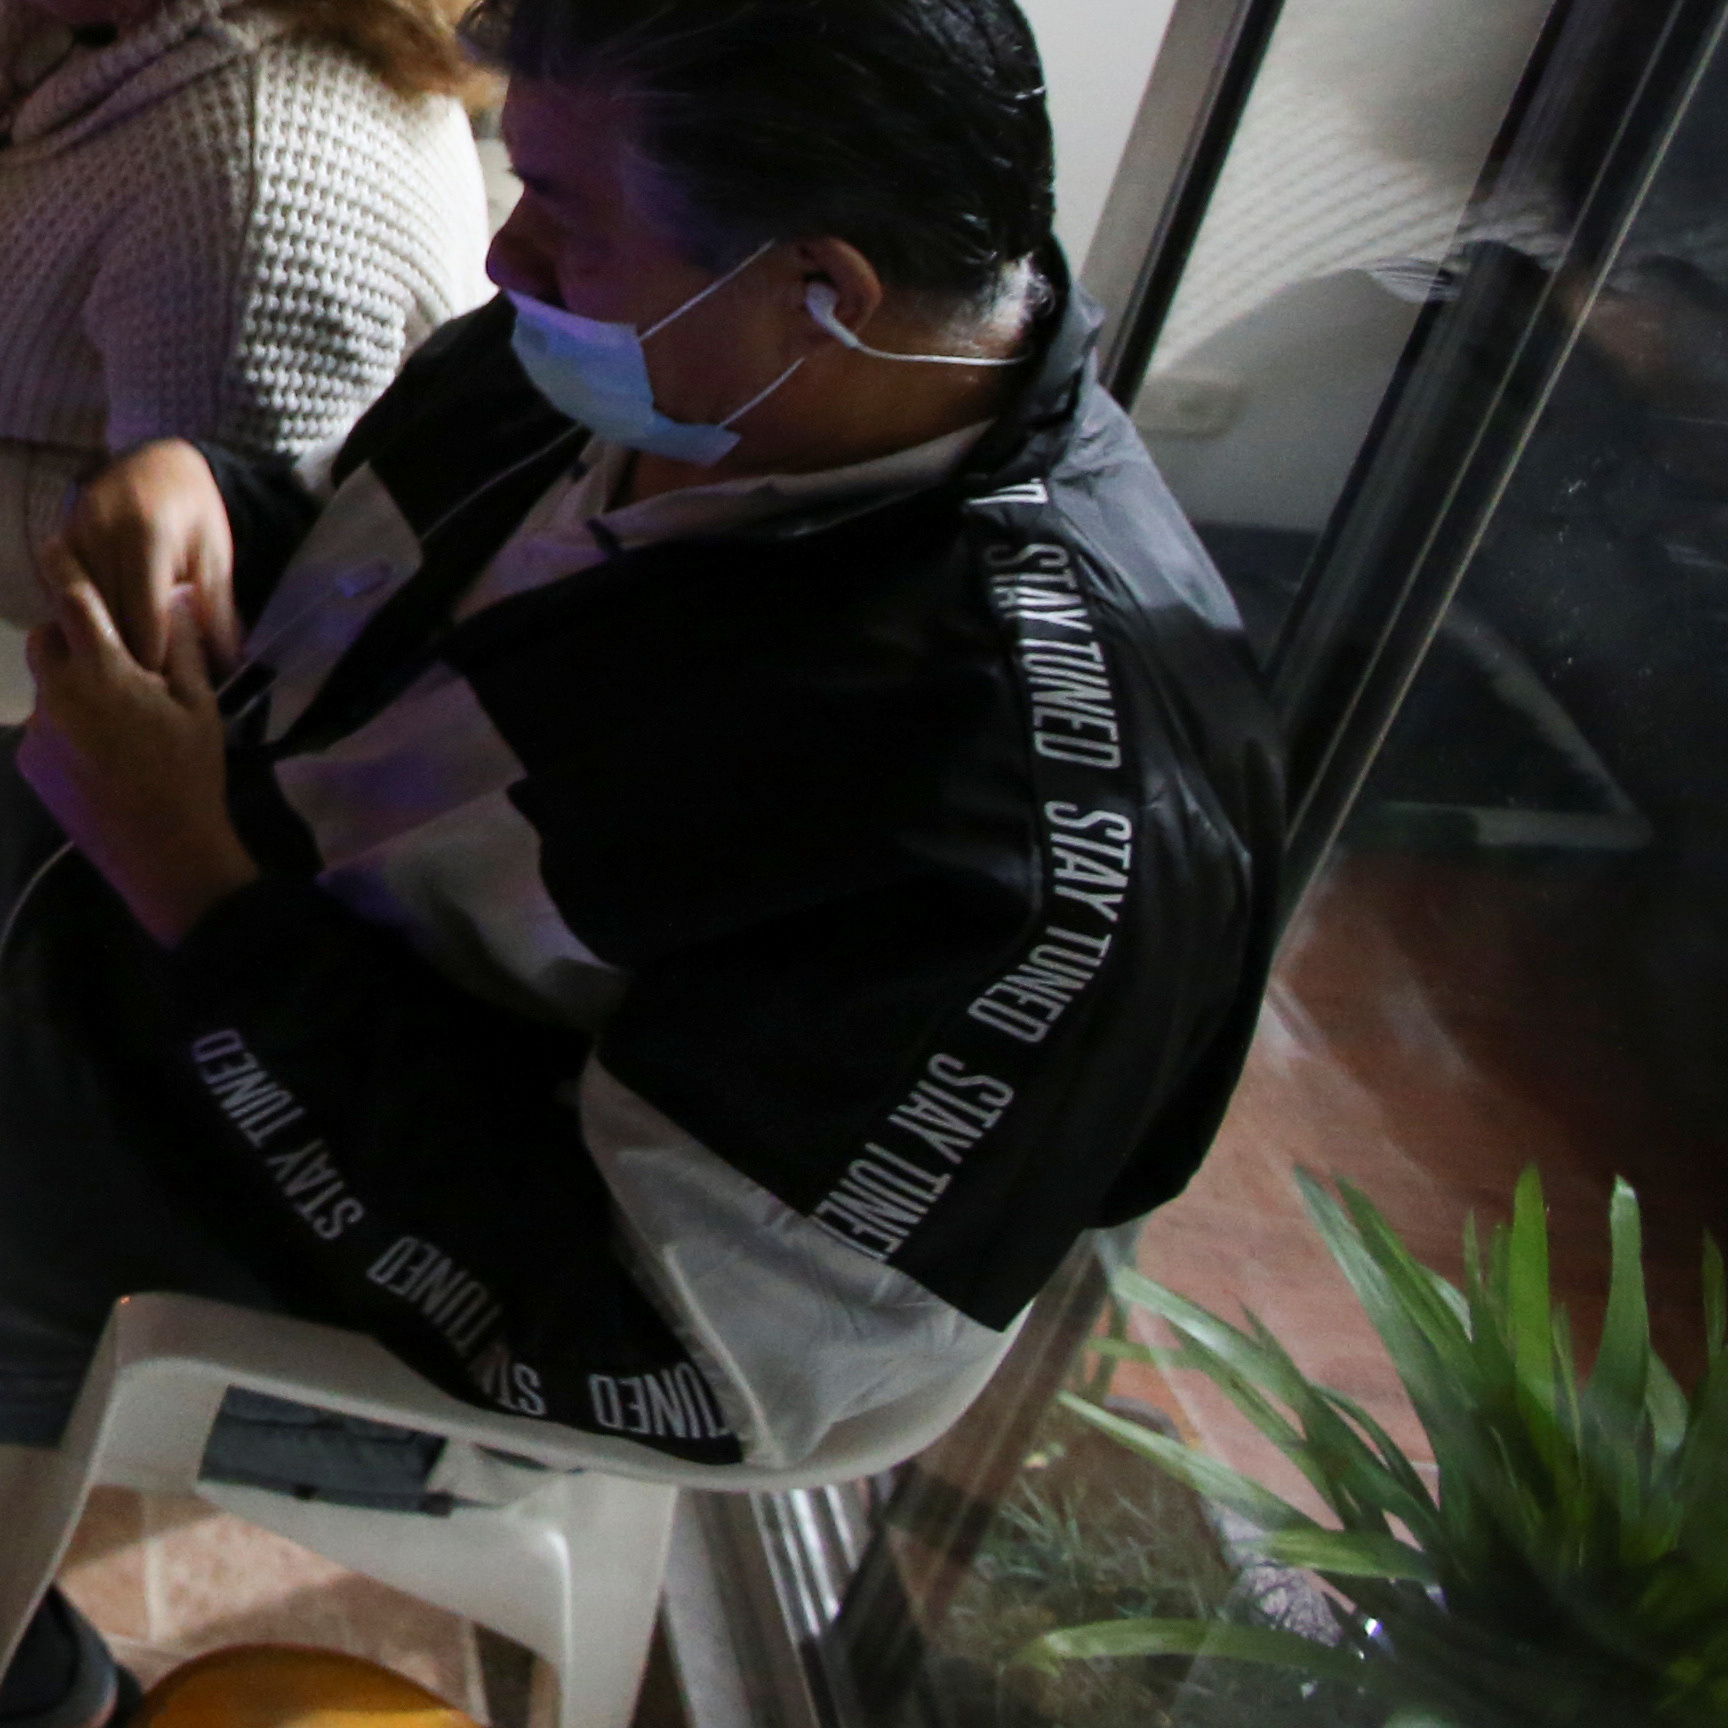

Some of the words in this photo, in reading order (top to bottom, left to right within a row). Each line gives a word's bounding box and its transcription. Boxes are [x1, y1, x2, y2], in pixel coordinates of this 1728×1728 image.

[985, 543, 1095, 633] STAY
[1019, 637, 1122, 770] TUNED
[1044, 800, 1133, 922] STAY
[966, 924, 1113, 1043] TUNED
[190, 1026, 309, 1149] TUNED
[886, 1051, 1016, 1165] STAY
[264, 1137, 366, 1240] STAY
[365, 1234, 504, 1359] TUNED
[586, 1360, 730, 1440] UNED
